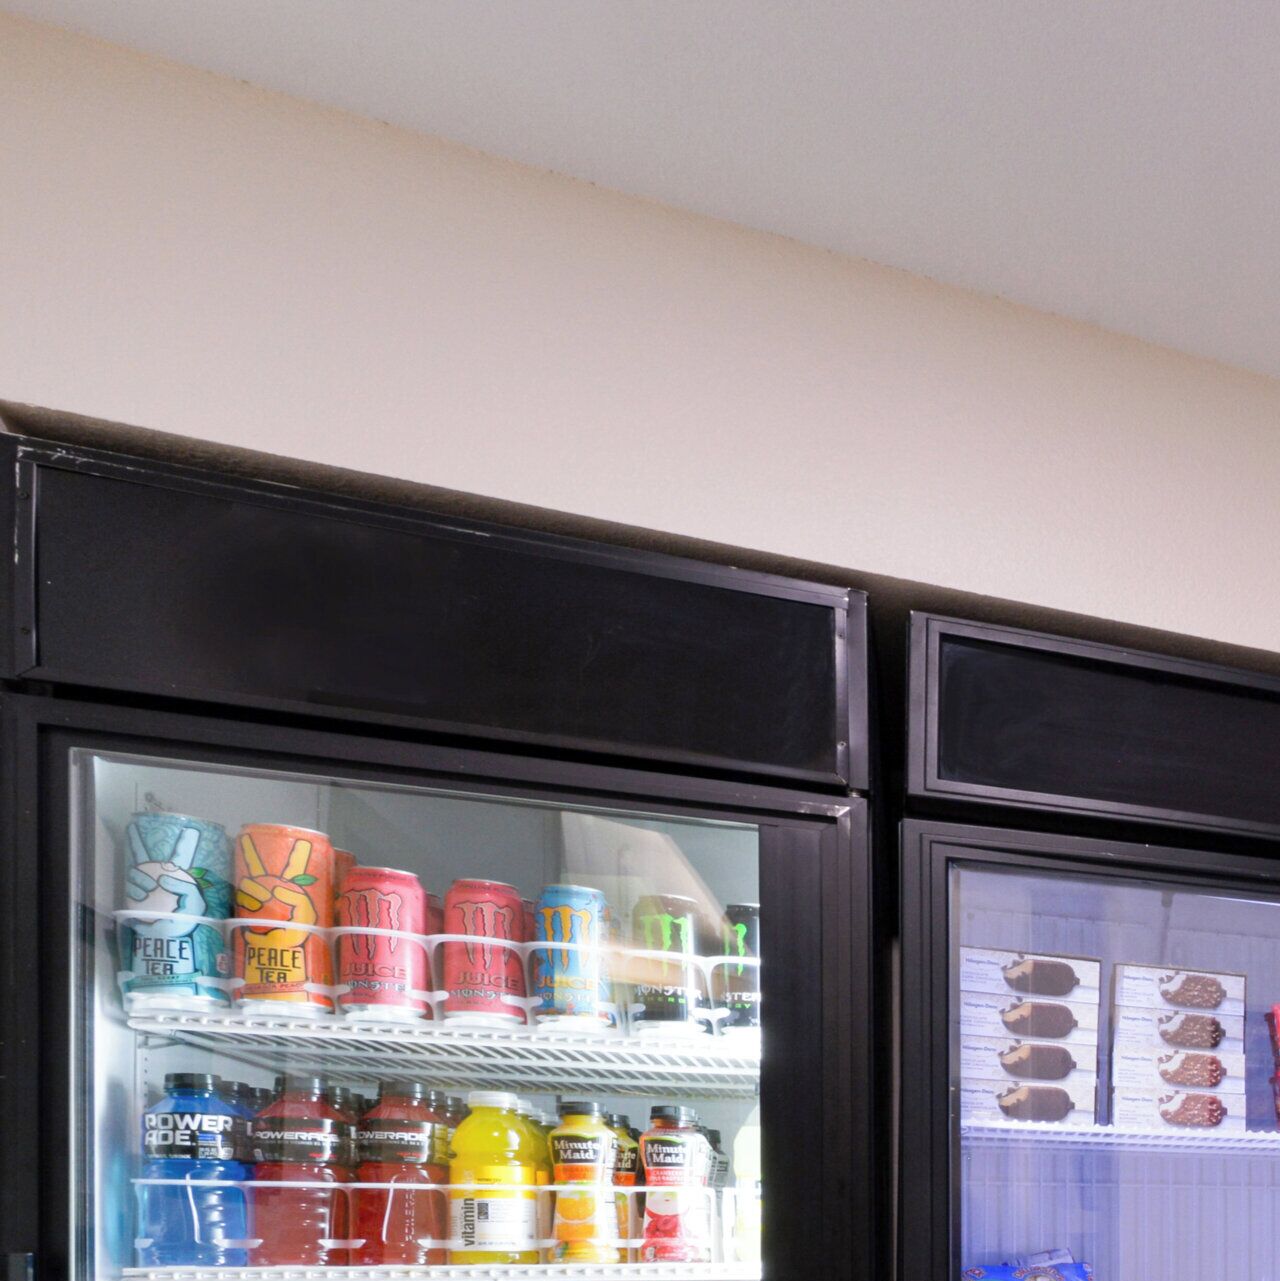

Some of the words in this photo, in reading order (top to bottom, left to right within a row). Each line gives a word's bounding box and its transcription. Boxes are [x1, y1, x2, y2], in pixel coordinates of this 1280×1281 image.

[134, 937, 189, 960] PEACE
[248, 946, 301, 969] PEACE
[145, 961, 175, 975] TEA
[258, 970, 288, 984] TEA
[457, 972, 519, 990] JUICE
[145, 1114, 233, 1131] POWER
[252, 1130, 339, 1142] POWERADE
[554, 1138, 600, 1151] Minute
[560, 1149, 594, 1161] Maid
[461, 1198, 475, 1247] vitamin
